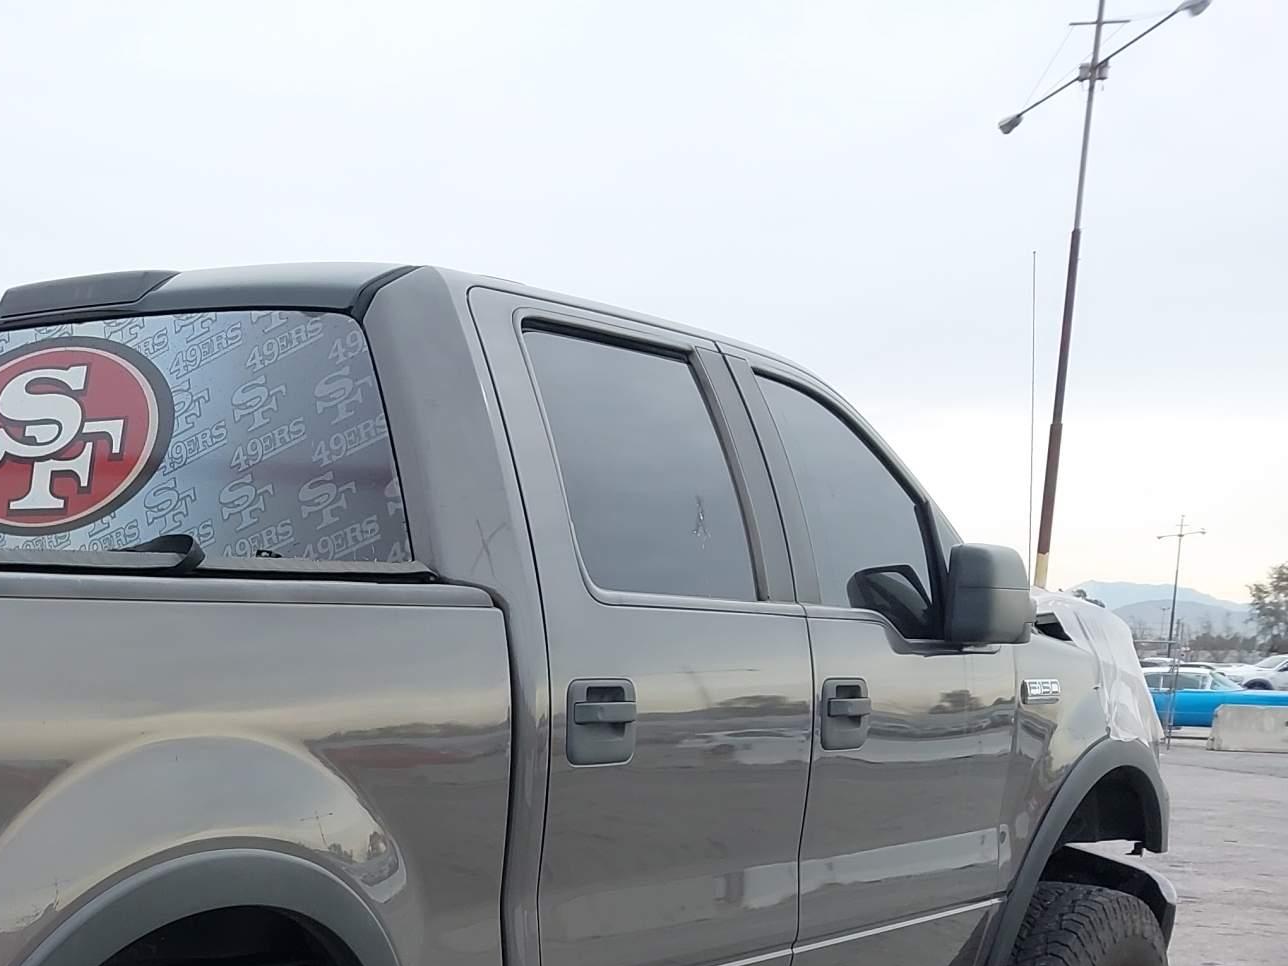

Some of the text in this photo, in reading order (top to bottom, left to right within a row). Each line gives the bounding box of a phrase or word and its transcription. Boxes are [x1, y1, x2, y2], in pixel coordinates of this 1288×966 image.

[169, 322, 242, 379] 49ERS
[246, 316, 324, 373] 49ERS
[231, 375, 287, 432] SF
[230, 416, 308, 472] 49ERS
[144, 476, 196, 534] SF
[219, 474, 274, 531] SF
[298, 471, 357, 530] SF
